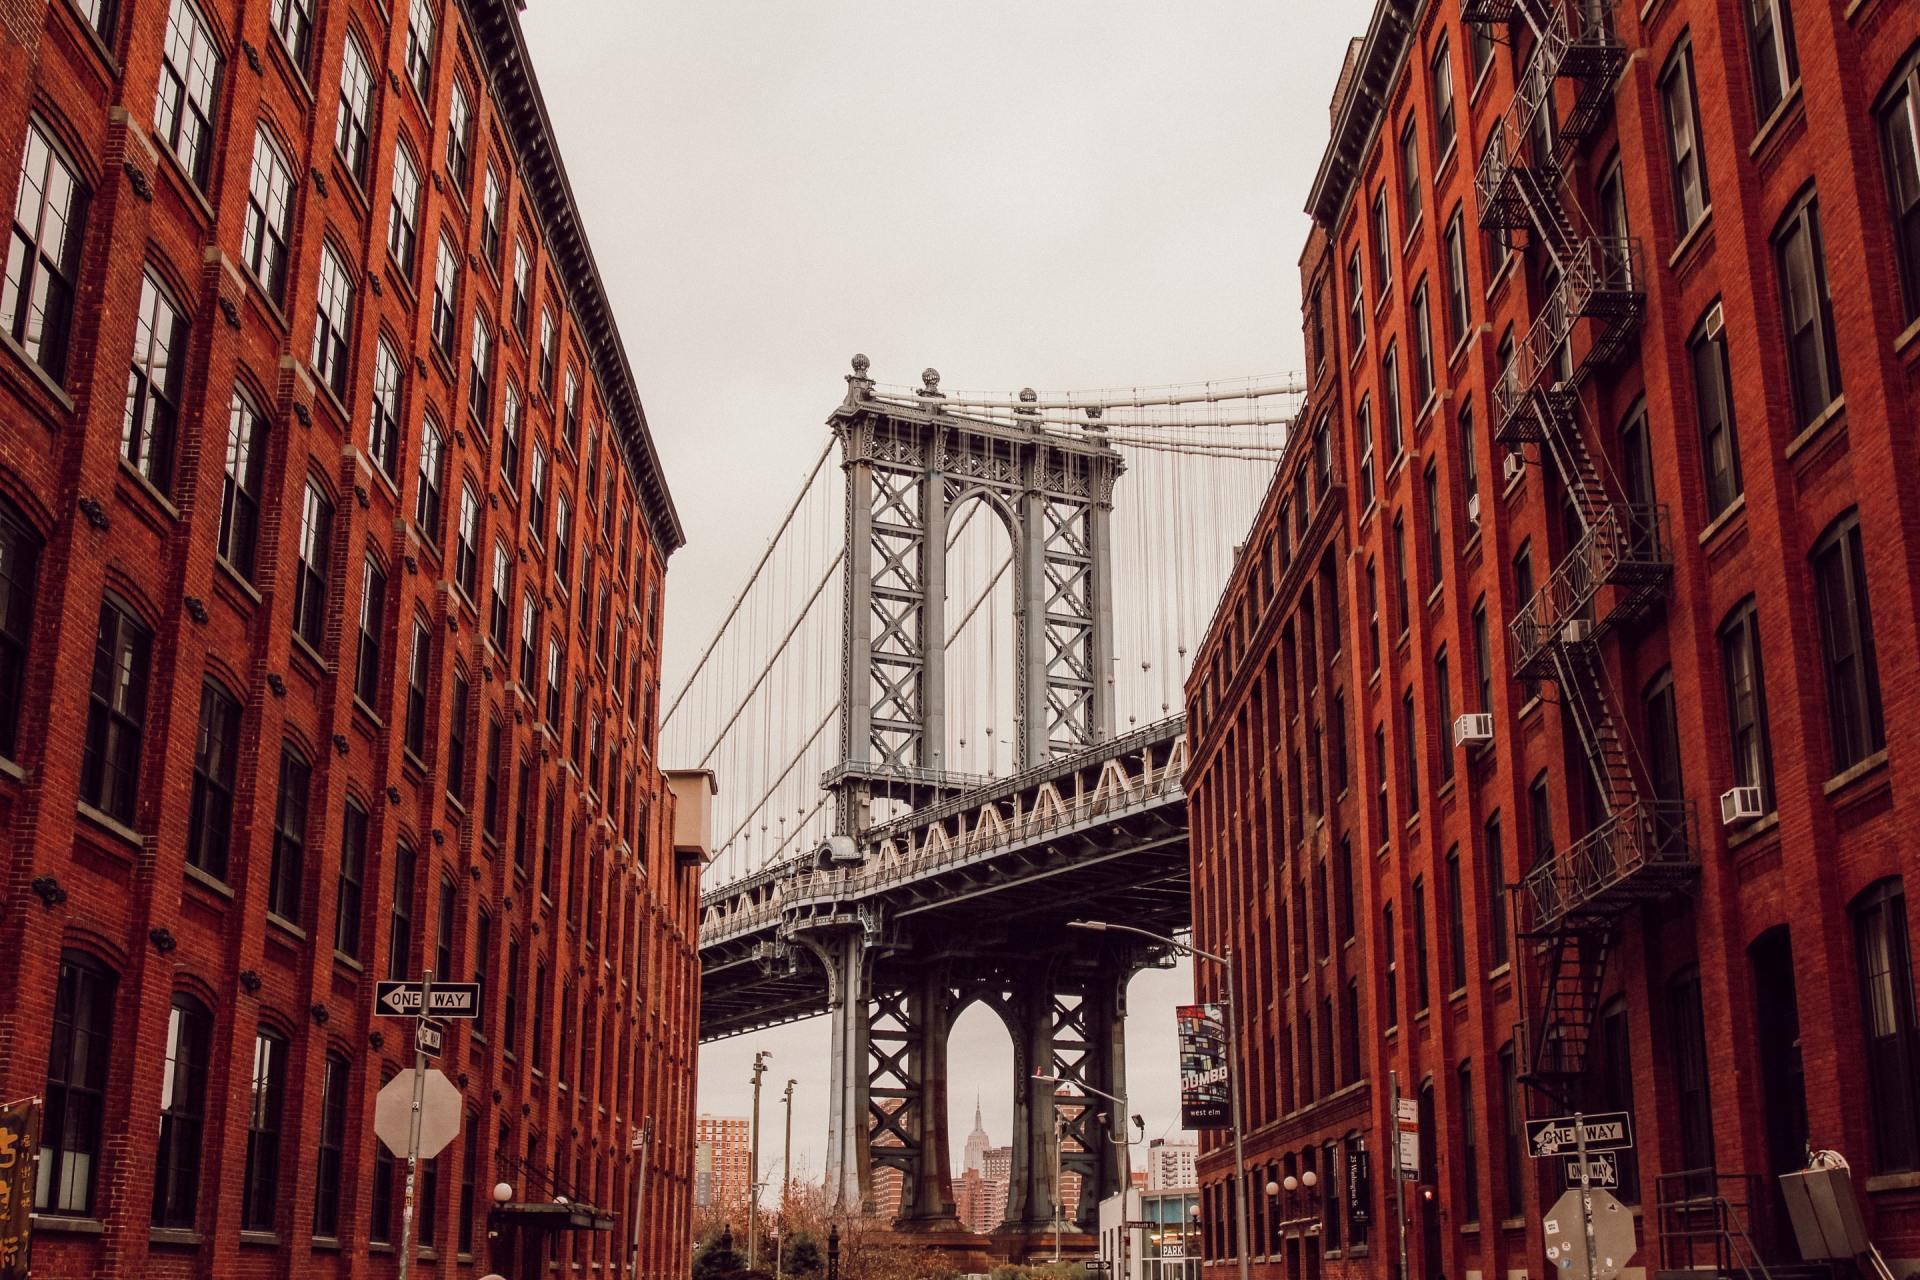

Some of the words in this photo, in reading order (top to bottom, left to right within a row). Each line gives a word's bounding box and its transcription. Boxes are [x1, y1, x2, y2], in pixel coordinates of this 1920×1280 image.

[392, 992, 420, 1006] ONE
[434, 993, 465, 1007] WAY
[419, 1027, 428, 1043] ONE
[430, 1033, 440, 1047] WAY
[1181, 1066, 1228, 1091] DUMBO
[1190, 1109, 1207, 1117] west
[1208, 1109, 1221, 1117] elm
[1543, 1128, 1572, 1145] ONE
[1586, 1124, 1616, 1140] WAY
[1571, 1164, 1581, 1177] ON
[1591, 1164, 1608, 1177] WAY
[1349, 1164, 1358, 1199] Washington
[1163, 1245, 1183, 1257] PARK
